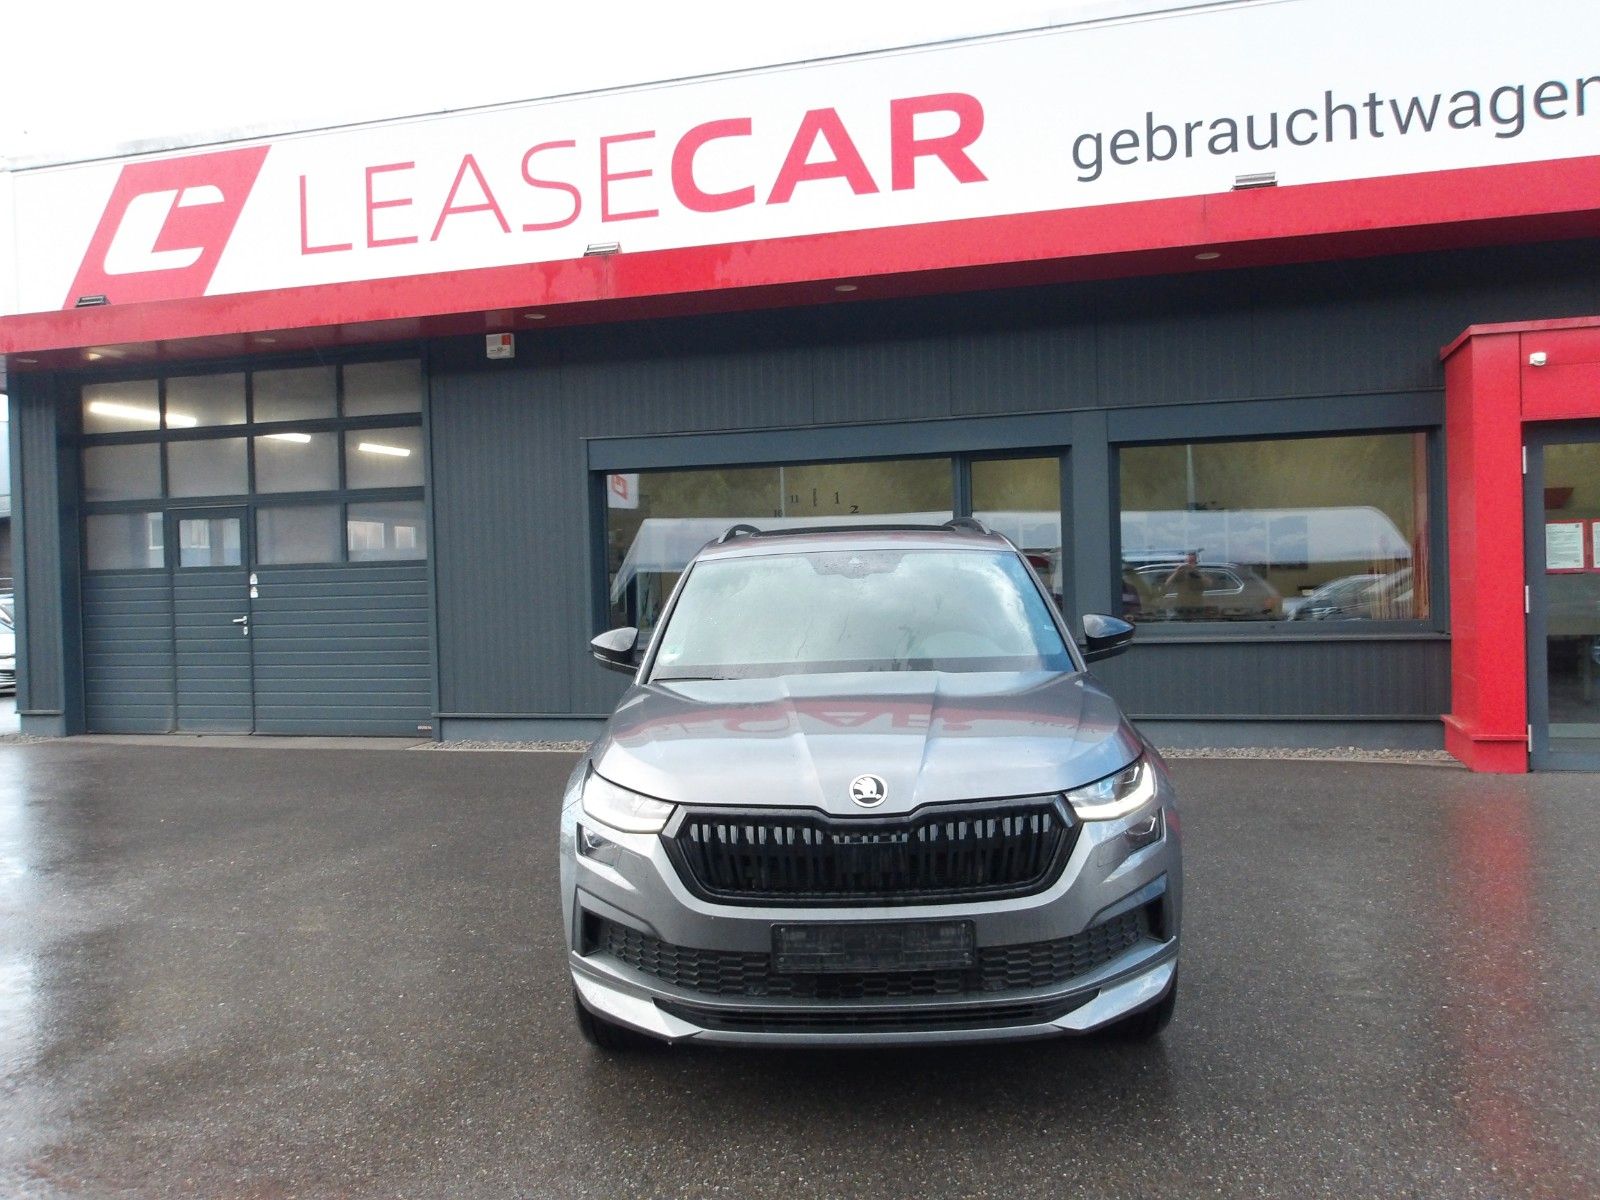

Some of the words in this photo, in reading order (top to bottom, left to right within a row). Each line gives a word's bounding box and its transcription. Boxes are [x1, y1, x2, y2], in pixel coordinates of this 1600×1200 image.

[300, 93, 987, 255] LEASECAR
[1072, 76, 1600, 183] gebrauchtwagen
[849, 505, 860, 514] 2
